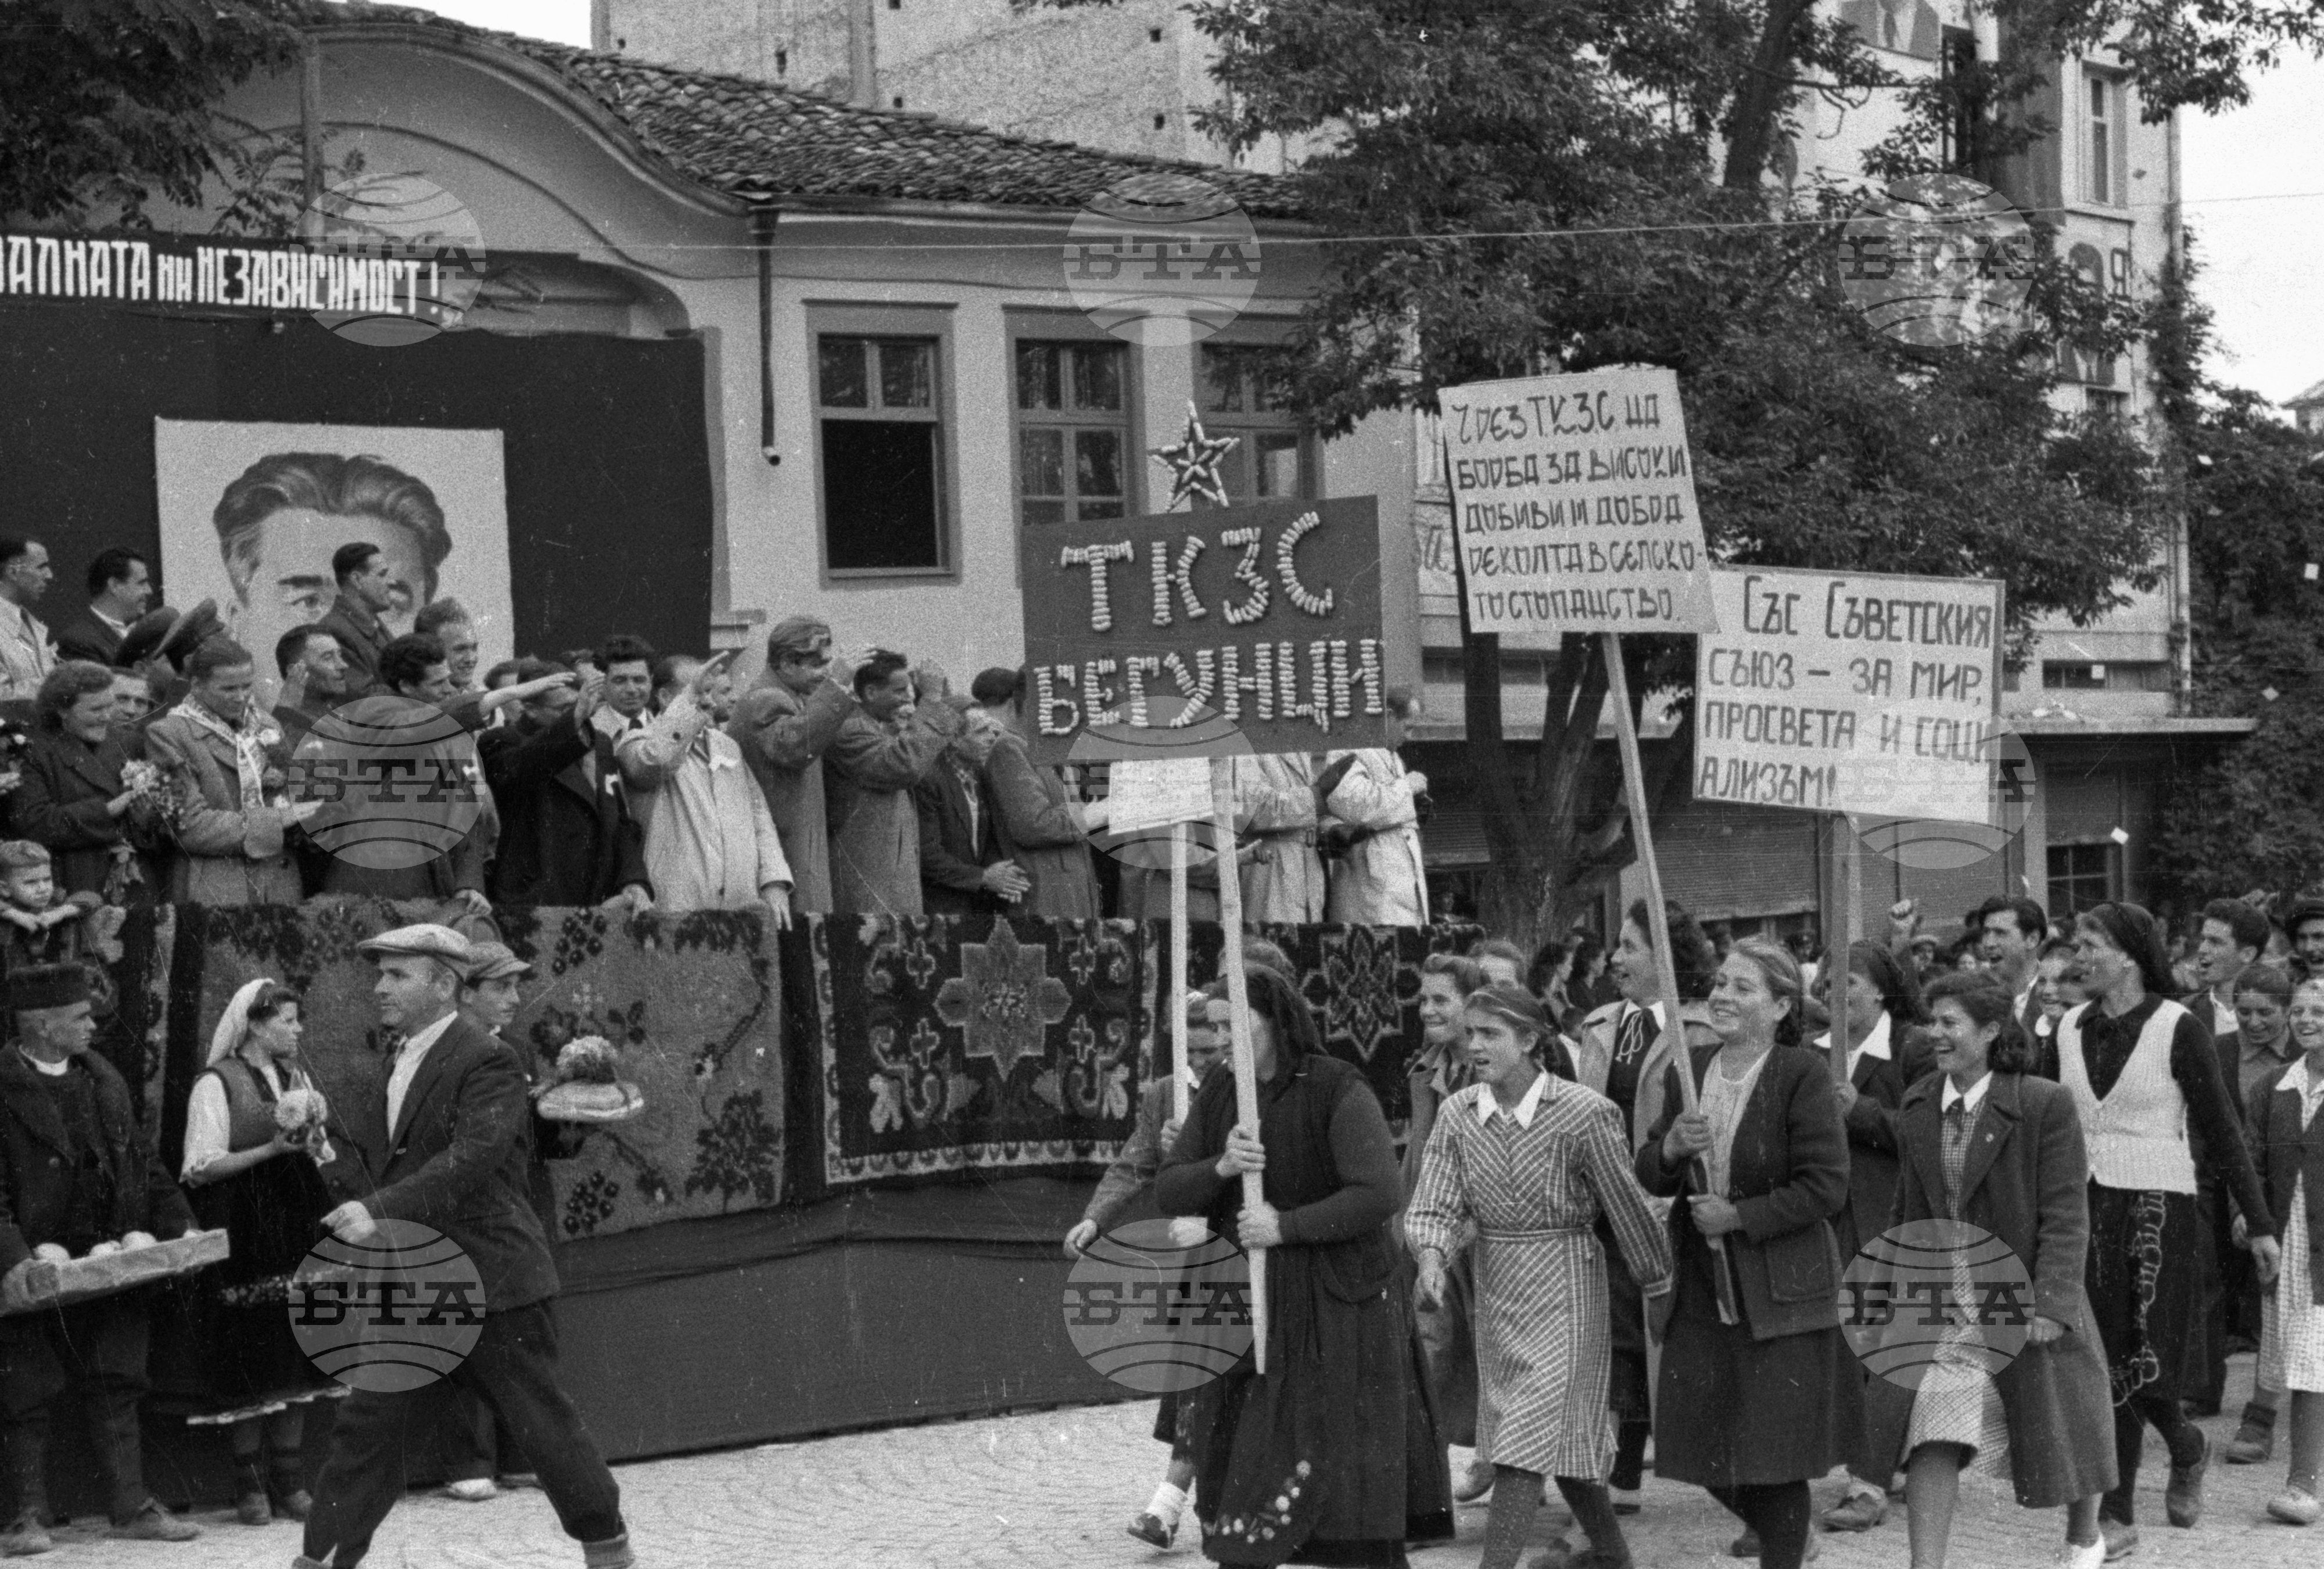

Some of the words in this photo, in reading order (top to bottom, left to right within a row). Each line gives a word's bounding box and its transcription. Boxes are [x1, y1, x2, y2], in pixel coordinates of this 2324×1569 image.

[0, 235, 150, 300] АЛНАТА
[1452, 404, 1528, 444] ЧРЕЗ
[1545, 450, 1581, 484] ЗА
[1465, 498, 1565, 534] ДОБИВИ
[1570, 498, 1588, 527] И
[1061, 511, 1333, 632] ТКЗС
[1468, 542, 1583, 576] РЕКОЛТА
[1034, 639, 1383, 734] БЕГУНЦИ
[1708, 647, 1794, 691] СЪЮЗ
[1848, 658, 1892, 697] ЗА
[1705, 701, 1856, 750] ПРОСВЕТА
[1880, 714, 1901, 754] И
